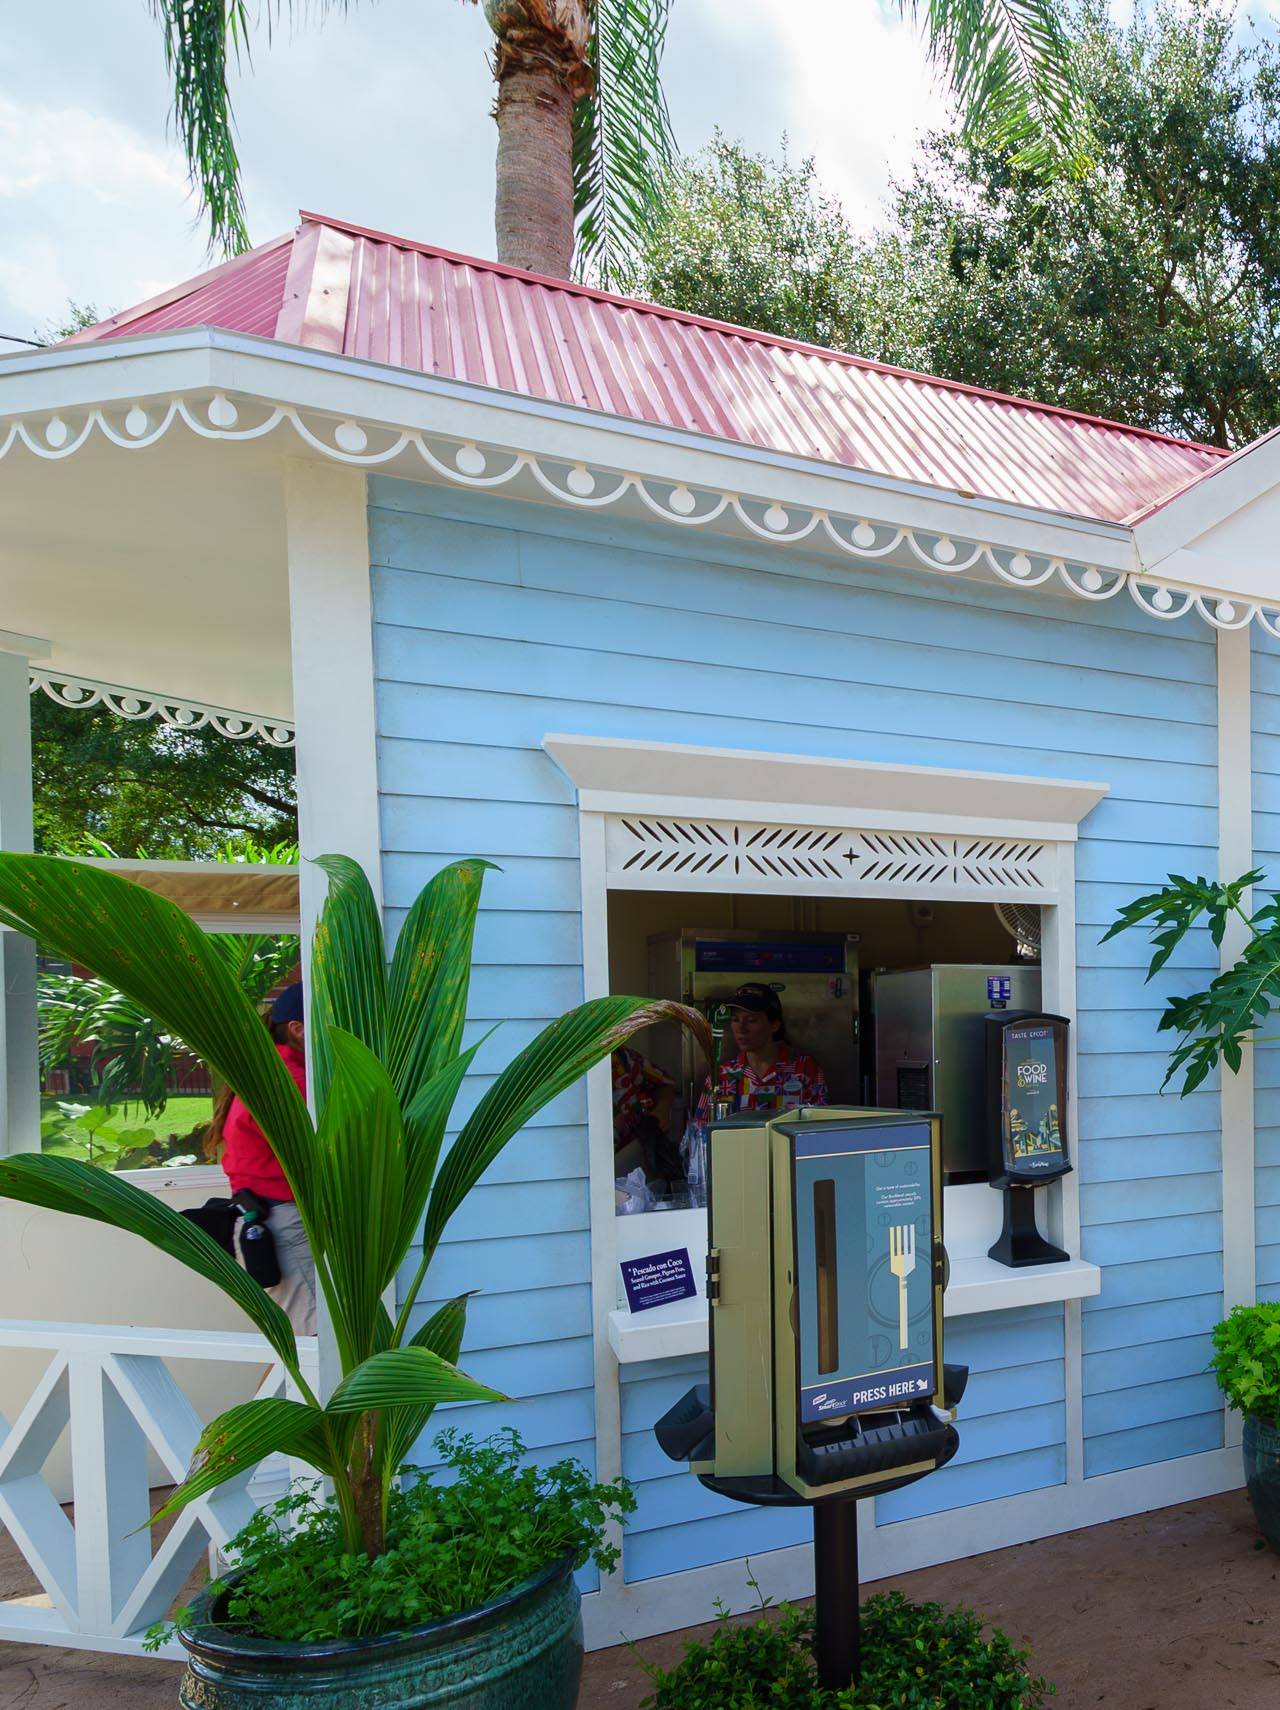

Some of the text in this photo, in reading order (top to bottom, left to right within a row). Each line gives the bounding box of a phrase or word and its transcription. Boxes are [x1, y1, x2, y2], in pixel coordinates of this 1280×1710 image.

[1017, 1064, 1047, 1076] FOOD
[1024, 1073, 1047, 1084] WINE
[632, 1264, 656, 1276] Pescado
[667, 1259, 682, 1267] Coco
[853, 1380, 915, 1405] PRESS HERE
